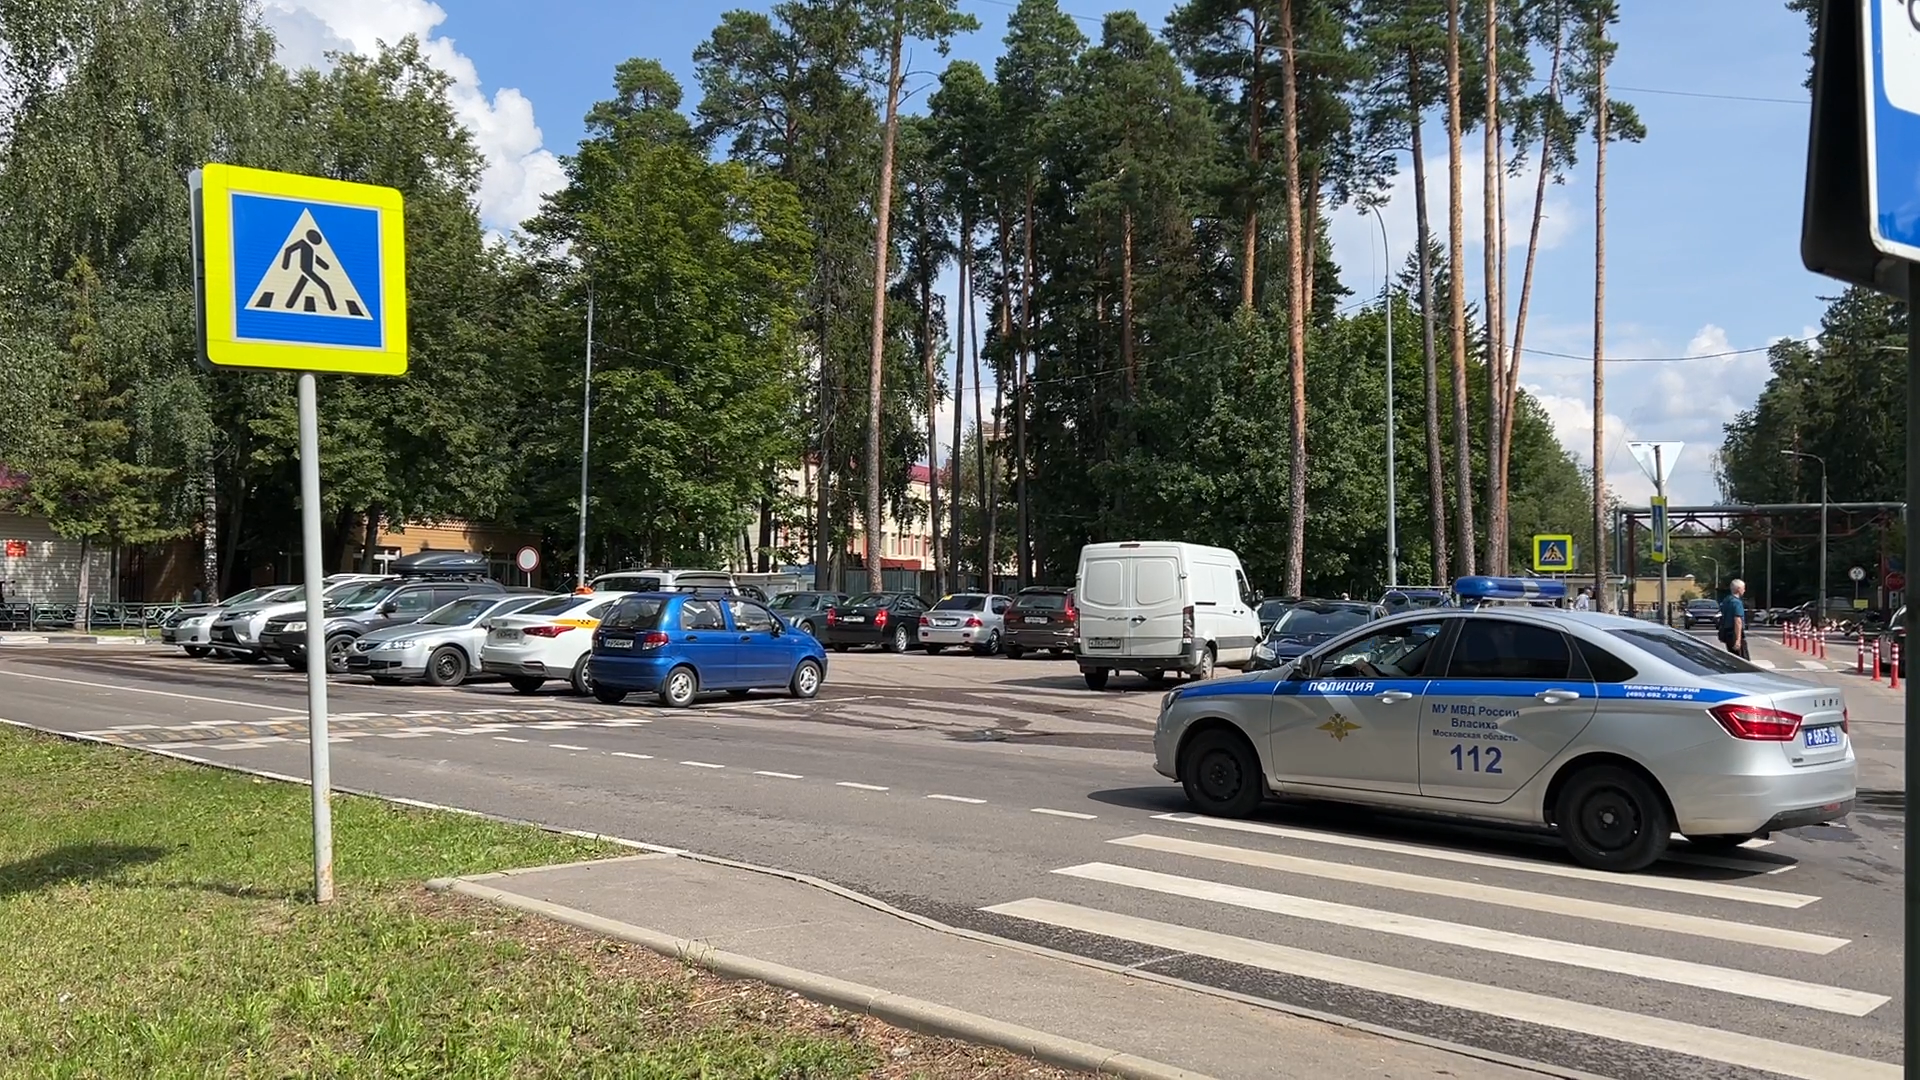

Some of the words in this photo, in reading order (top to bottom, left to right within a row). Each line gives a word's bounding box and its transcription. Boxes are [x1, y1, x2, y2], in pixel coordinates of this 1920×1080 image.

[1308, 682, 1375, 693] ПОЛИЦИЯ
[1432, 703, 1448, 714] МУ
[1451, 704, 1475, 716] МВД
[1479, 706, 1520, 717] России
[1452, 718, 1498, 730] Власиха
[1432, 729, 1481, 739] Московская
[1483, 733, 1519, 742] область
[1450, 744, 1503, 774] 112
